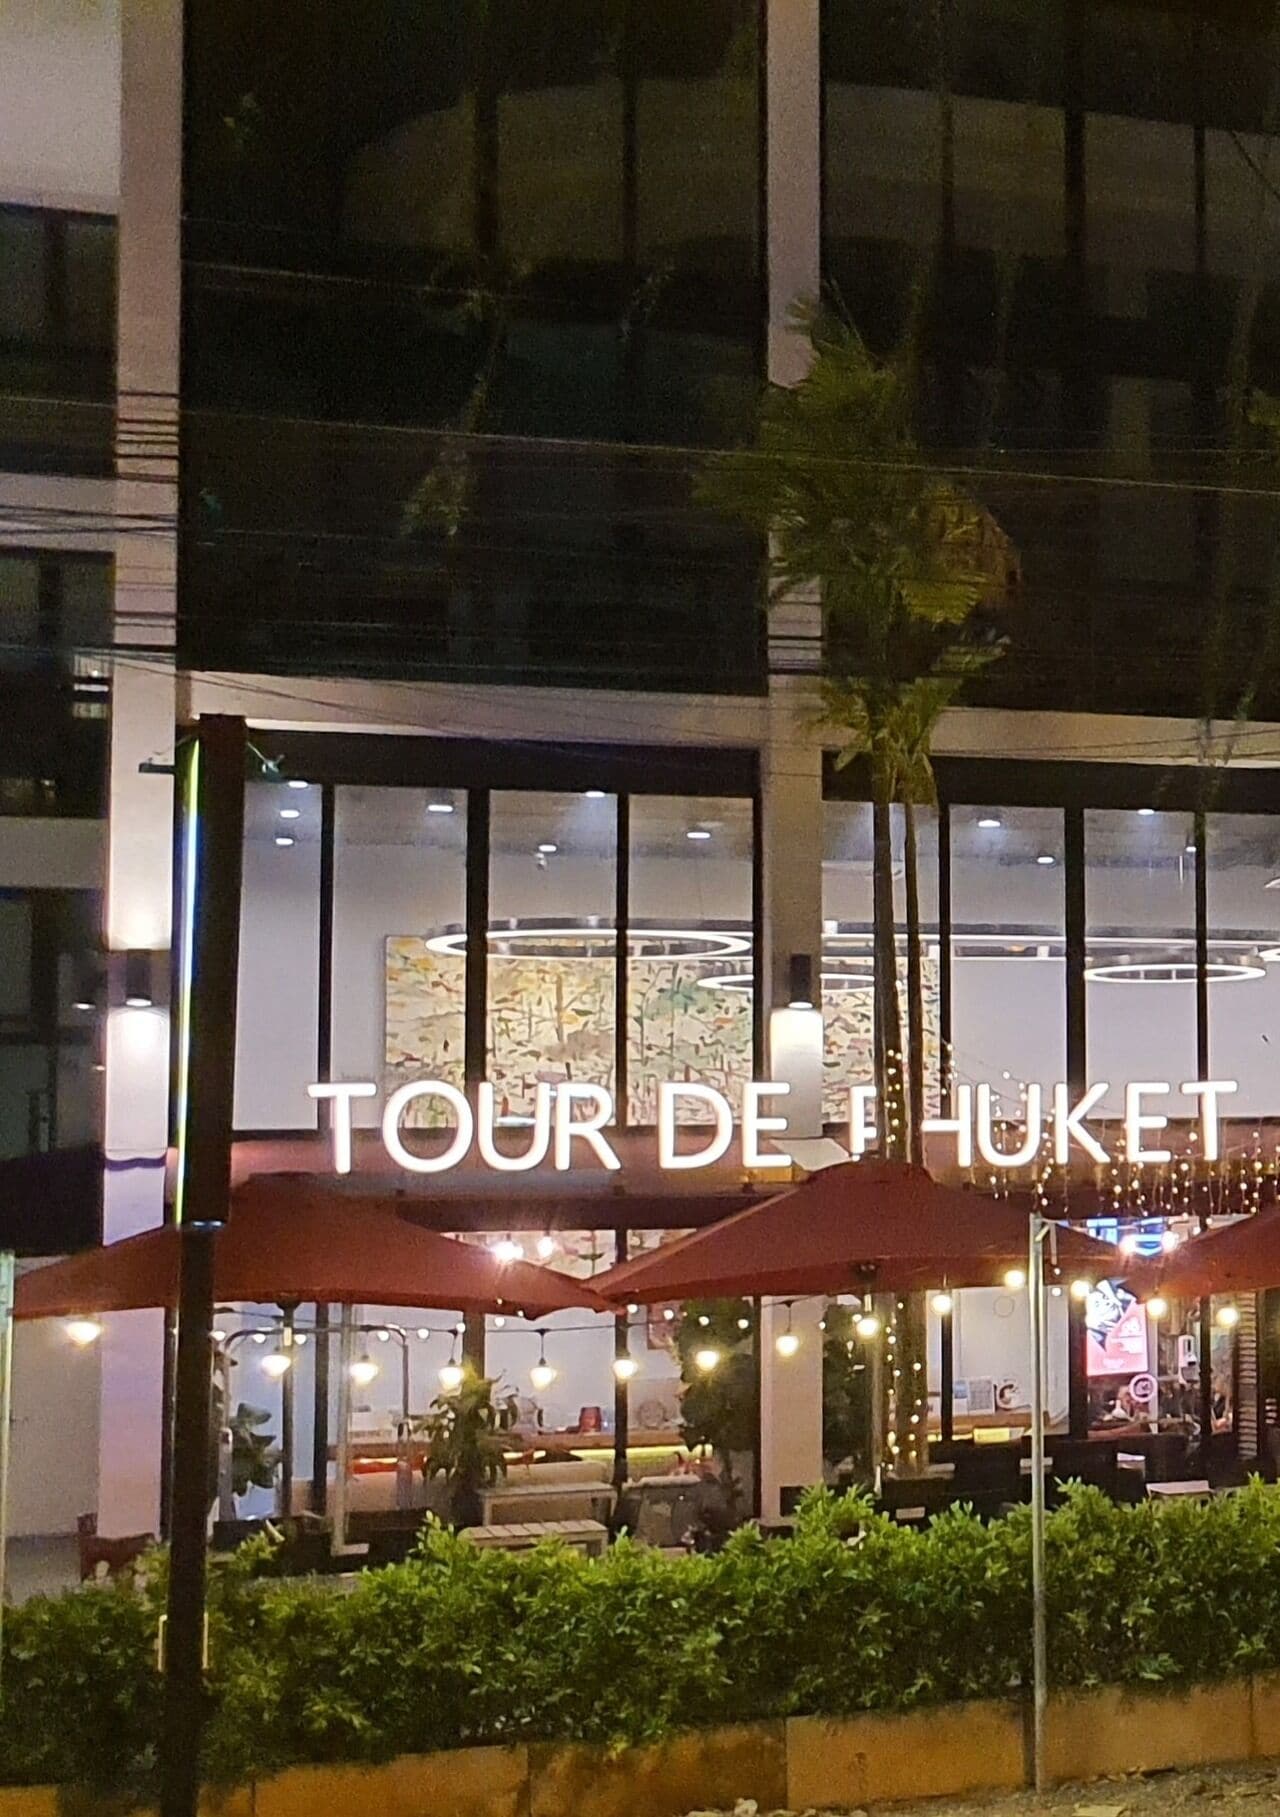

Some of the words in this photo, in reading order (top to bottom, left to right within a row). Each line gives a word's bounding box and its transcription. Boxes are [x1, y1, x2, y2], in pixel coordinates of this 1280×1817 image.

[307, 1080, 622, 1175] TOUR
[658, 1081, 793, 1169] DE
[849, 1080, 1239, 1168] PHUKET
